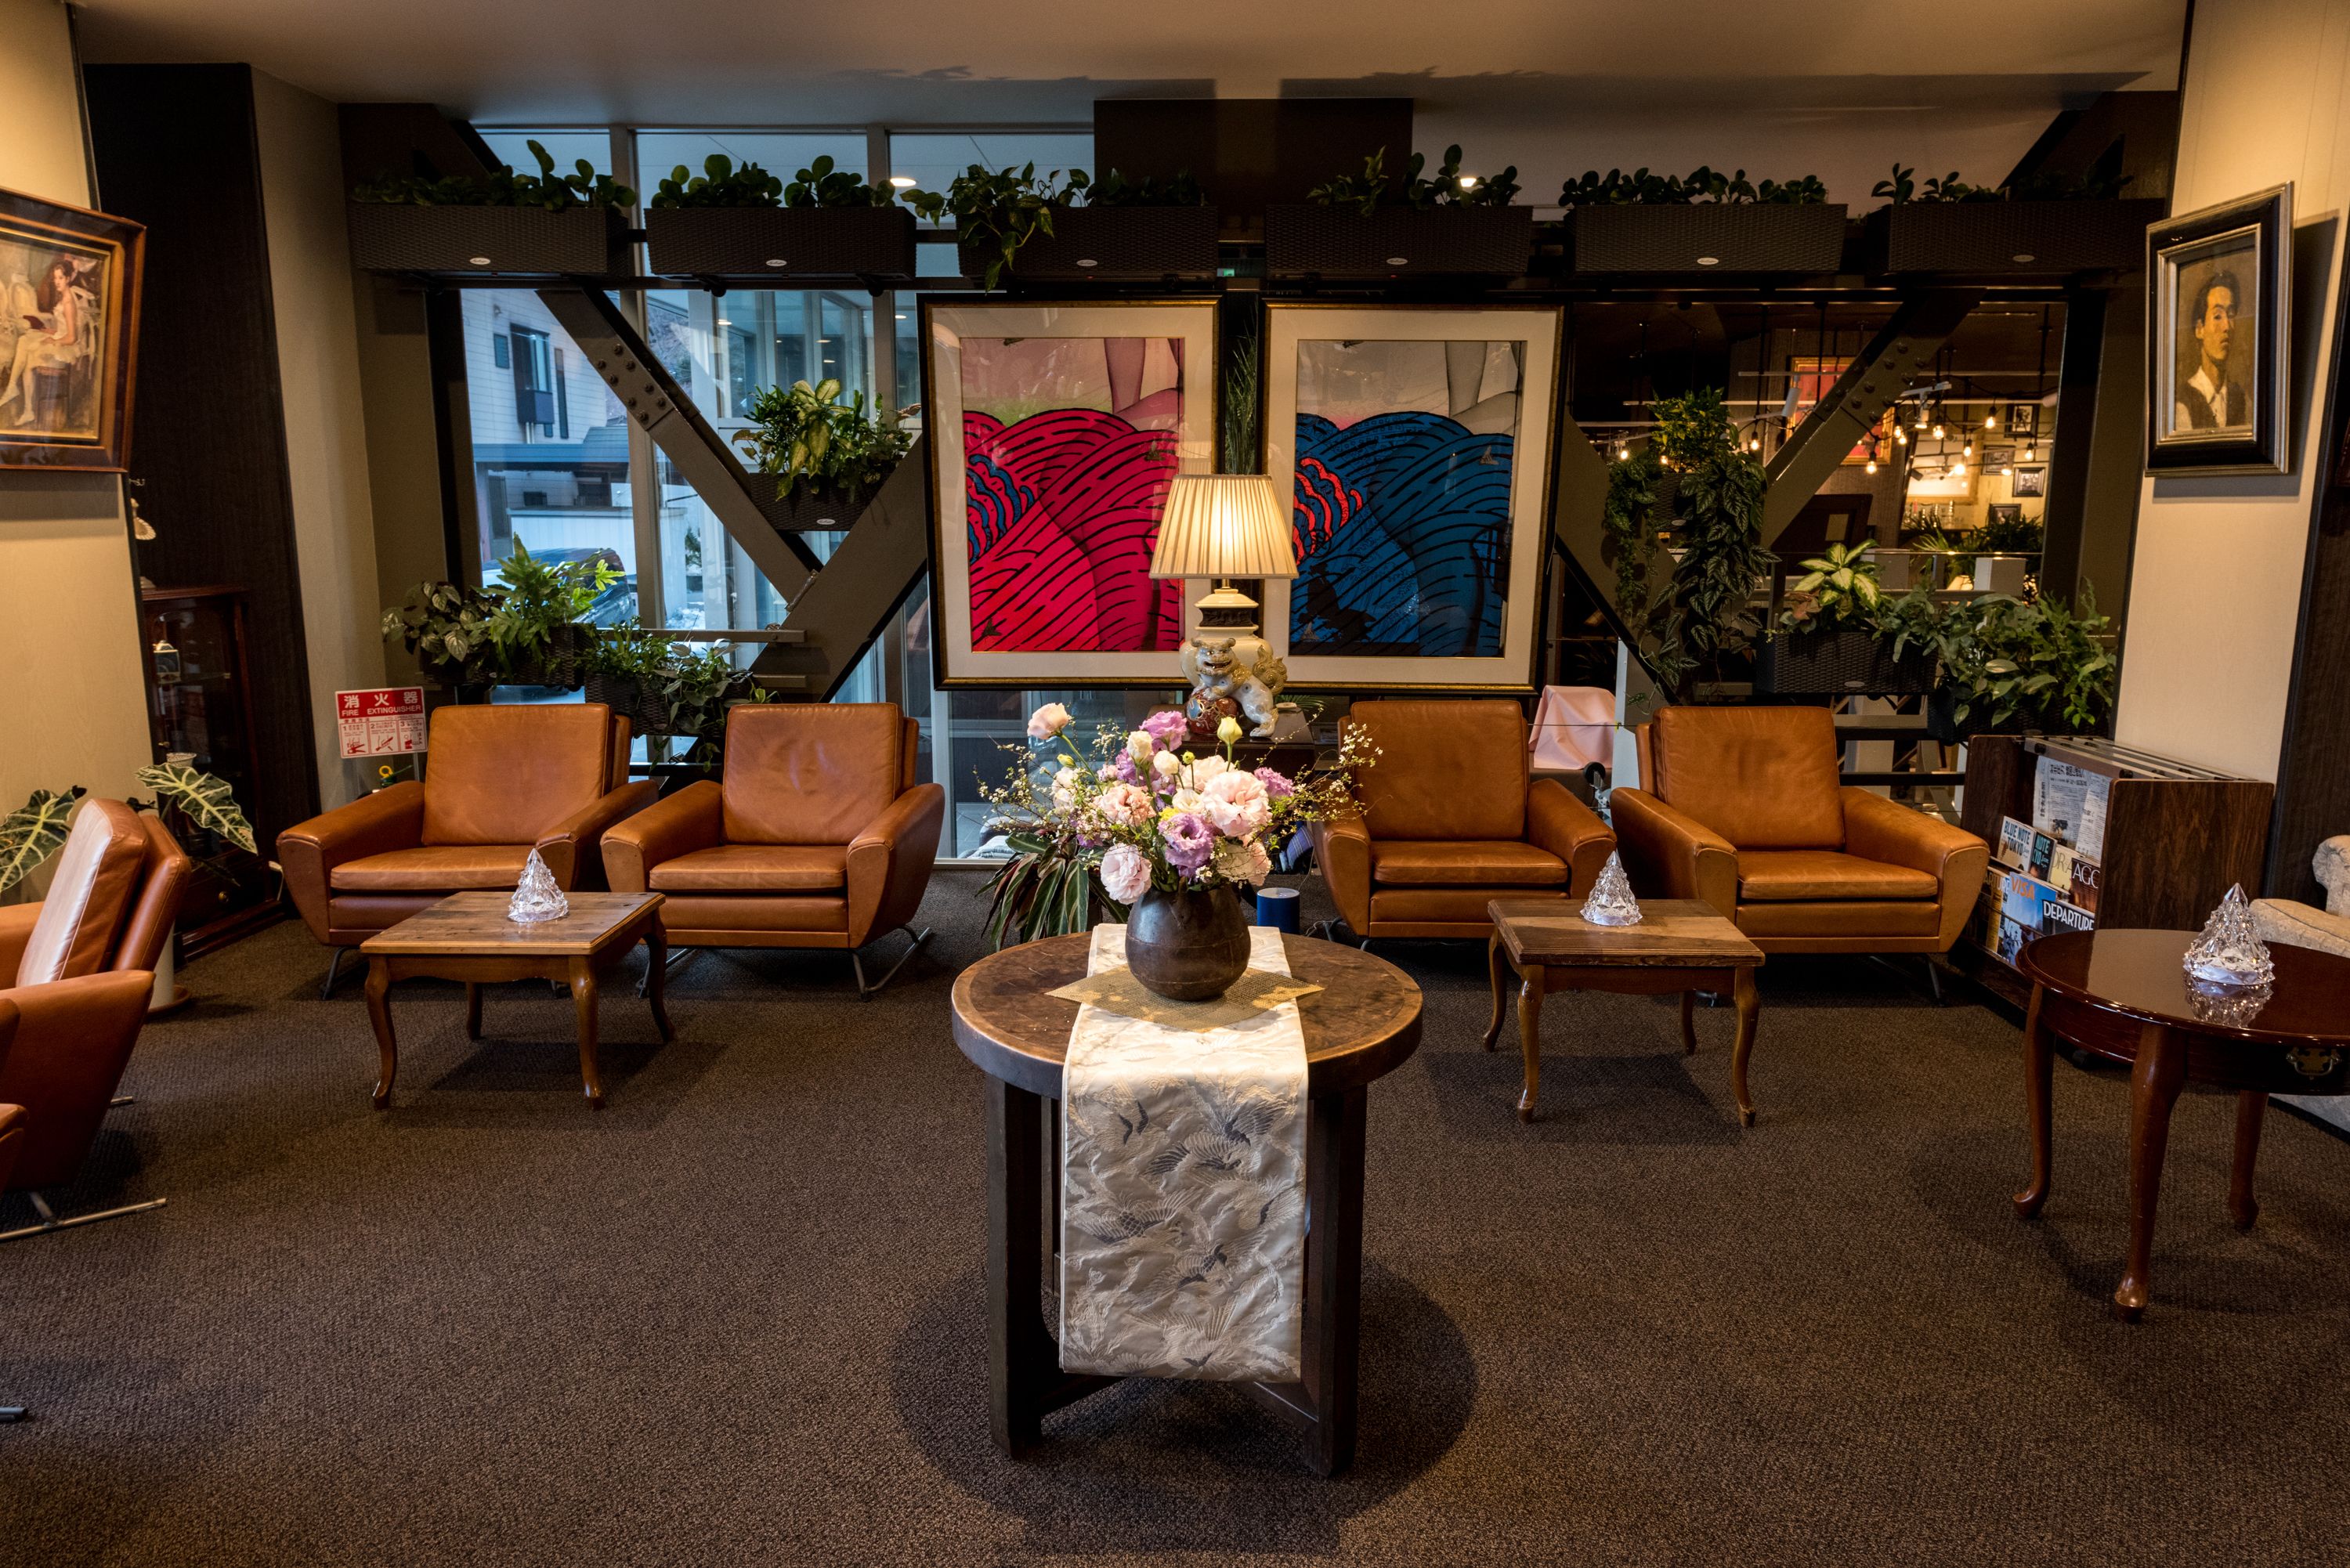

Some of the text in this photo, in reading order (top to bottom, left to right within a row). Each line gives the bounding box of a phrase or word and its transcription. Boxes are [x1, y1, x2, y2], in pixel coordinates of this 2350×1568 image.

[344, 691, 418, 709] 消火器
[367, 705, 421, 715] EXTINGUISHER
[2004, 820, 2031, 845] BLUE NOTE
[2008, 836, 2024, 856] TOKYO
[2011, 876, 2035, 901] VISA
[2043, 901, 2095, 931] DEPARTURE
